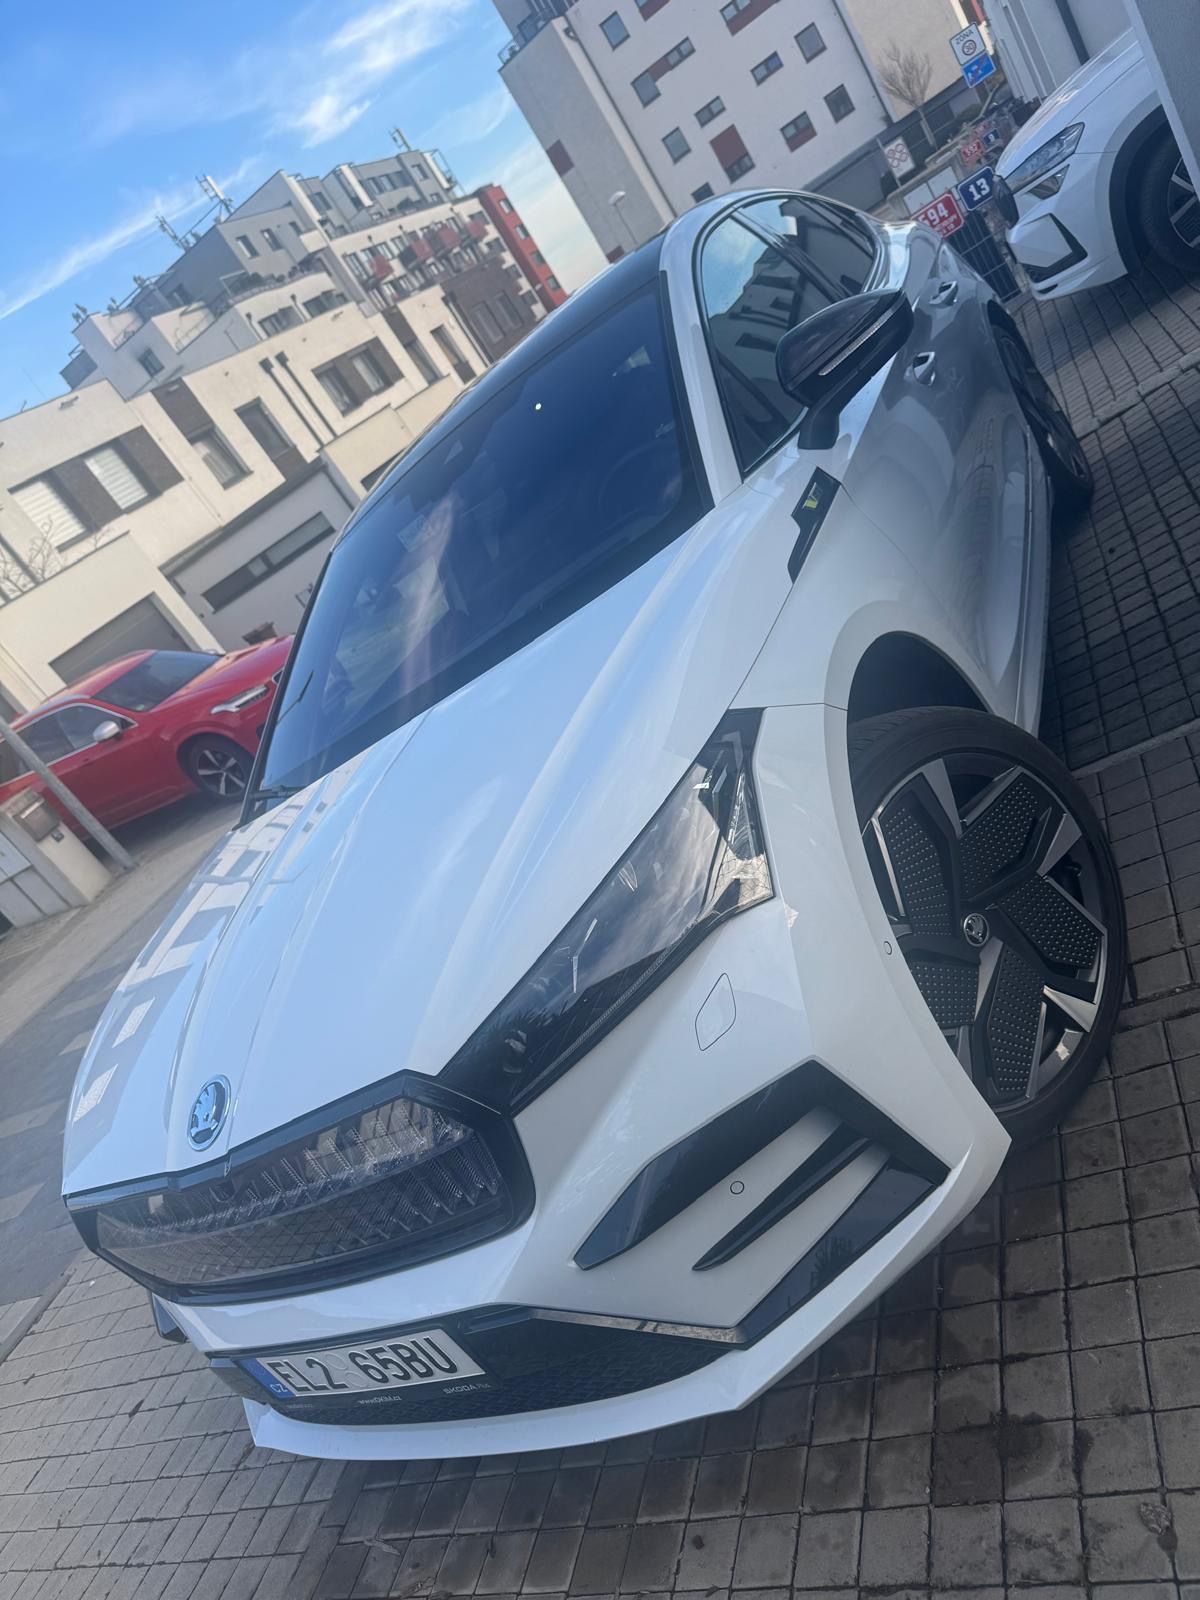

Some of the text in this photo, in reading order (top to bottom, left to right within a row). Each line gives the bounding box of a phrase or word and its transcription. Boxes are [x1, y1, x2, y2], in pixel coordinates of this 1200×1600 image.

[955, 29, 974, 45] ZONA
[968, 178, 990, 201] 13
[918, 202, 949, 228] 594
[266, 1336, 458, 1392] EL2 65BU
[270, 1383, 288, 1393] CZ
